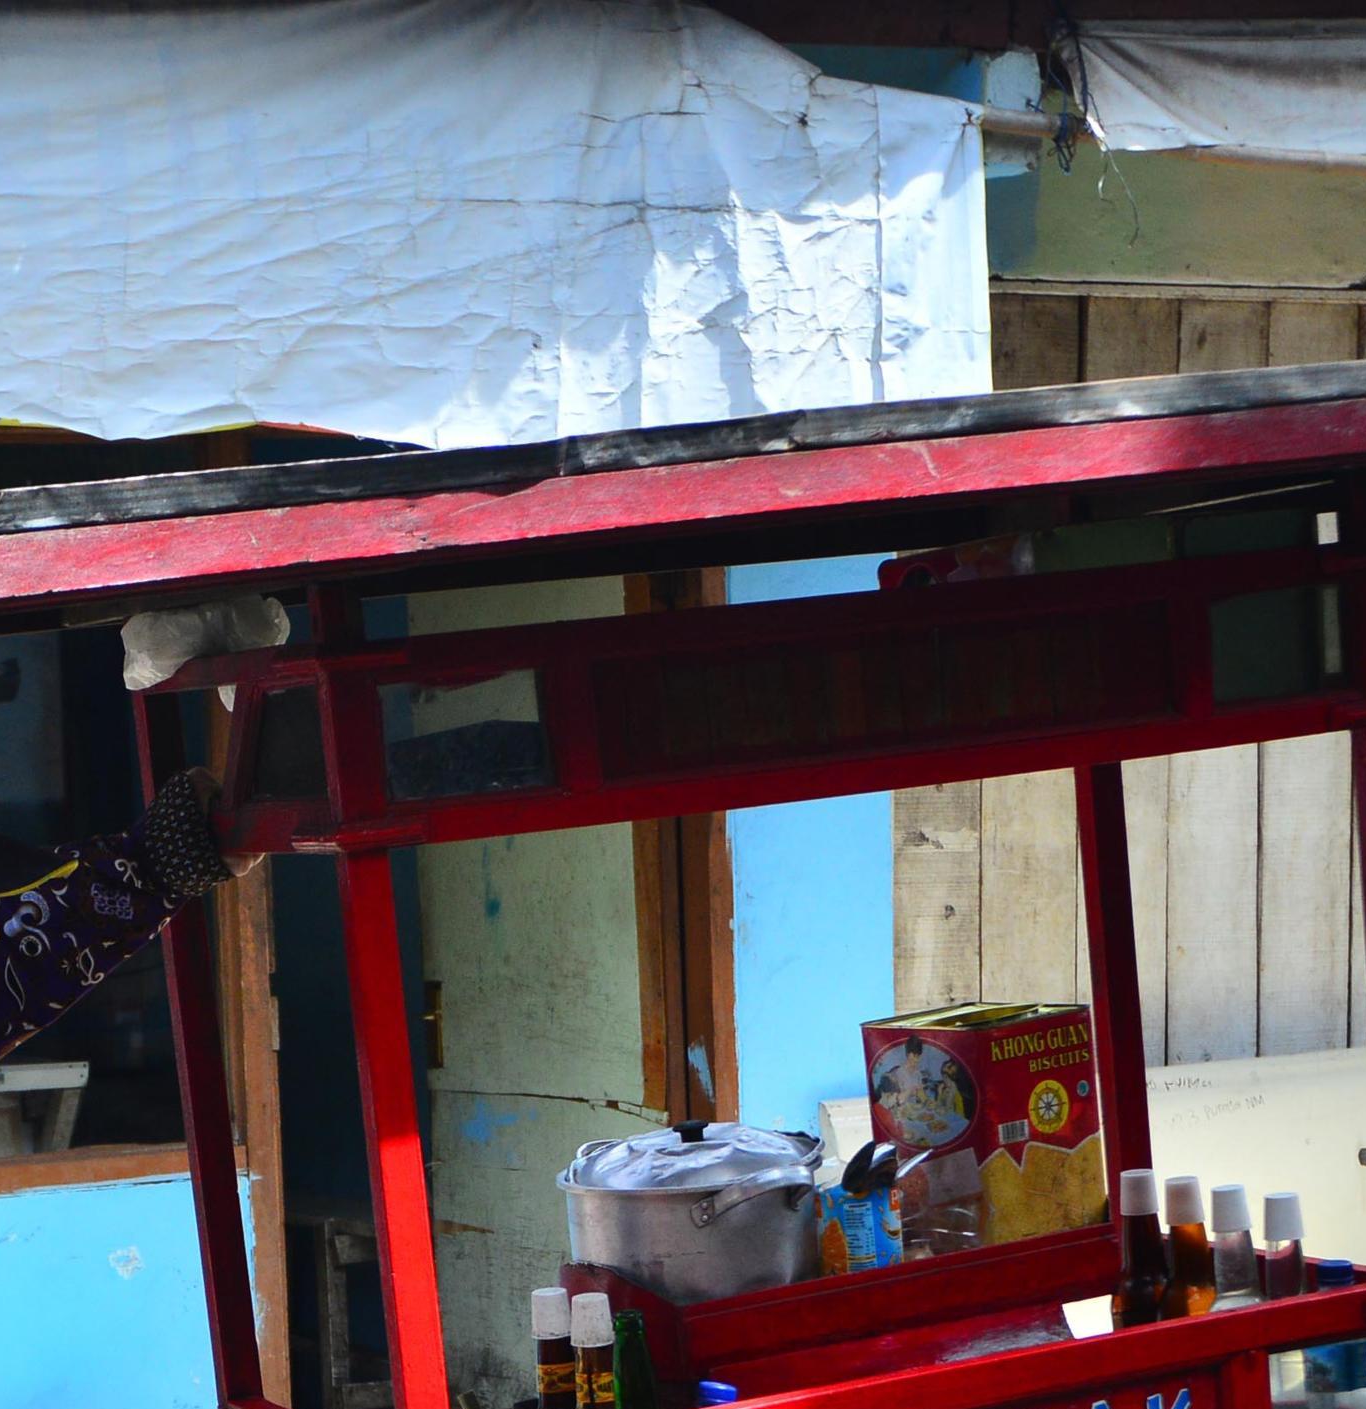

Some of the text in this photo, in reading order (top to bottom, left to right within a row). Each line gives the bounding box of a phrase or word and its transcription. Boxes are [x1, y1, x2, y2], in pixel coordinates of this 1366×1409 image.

[990, 1023, 1089, 1062] KHONG GUAN
[1029, 1048, 1090, 1073] BISCUITS
